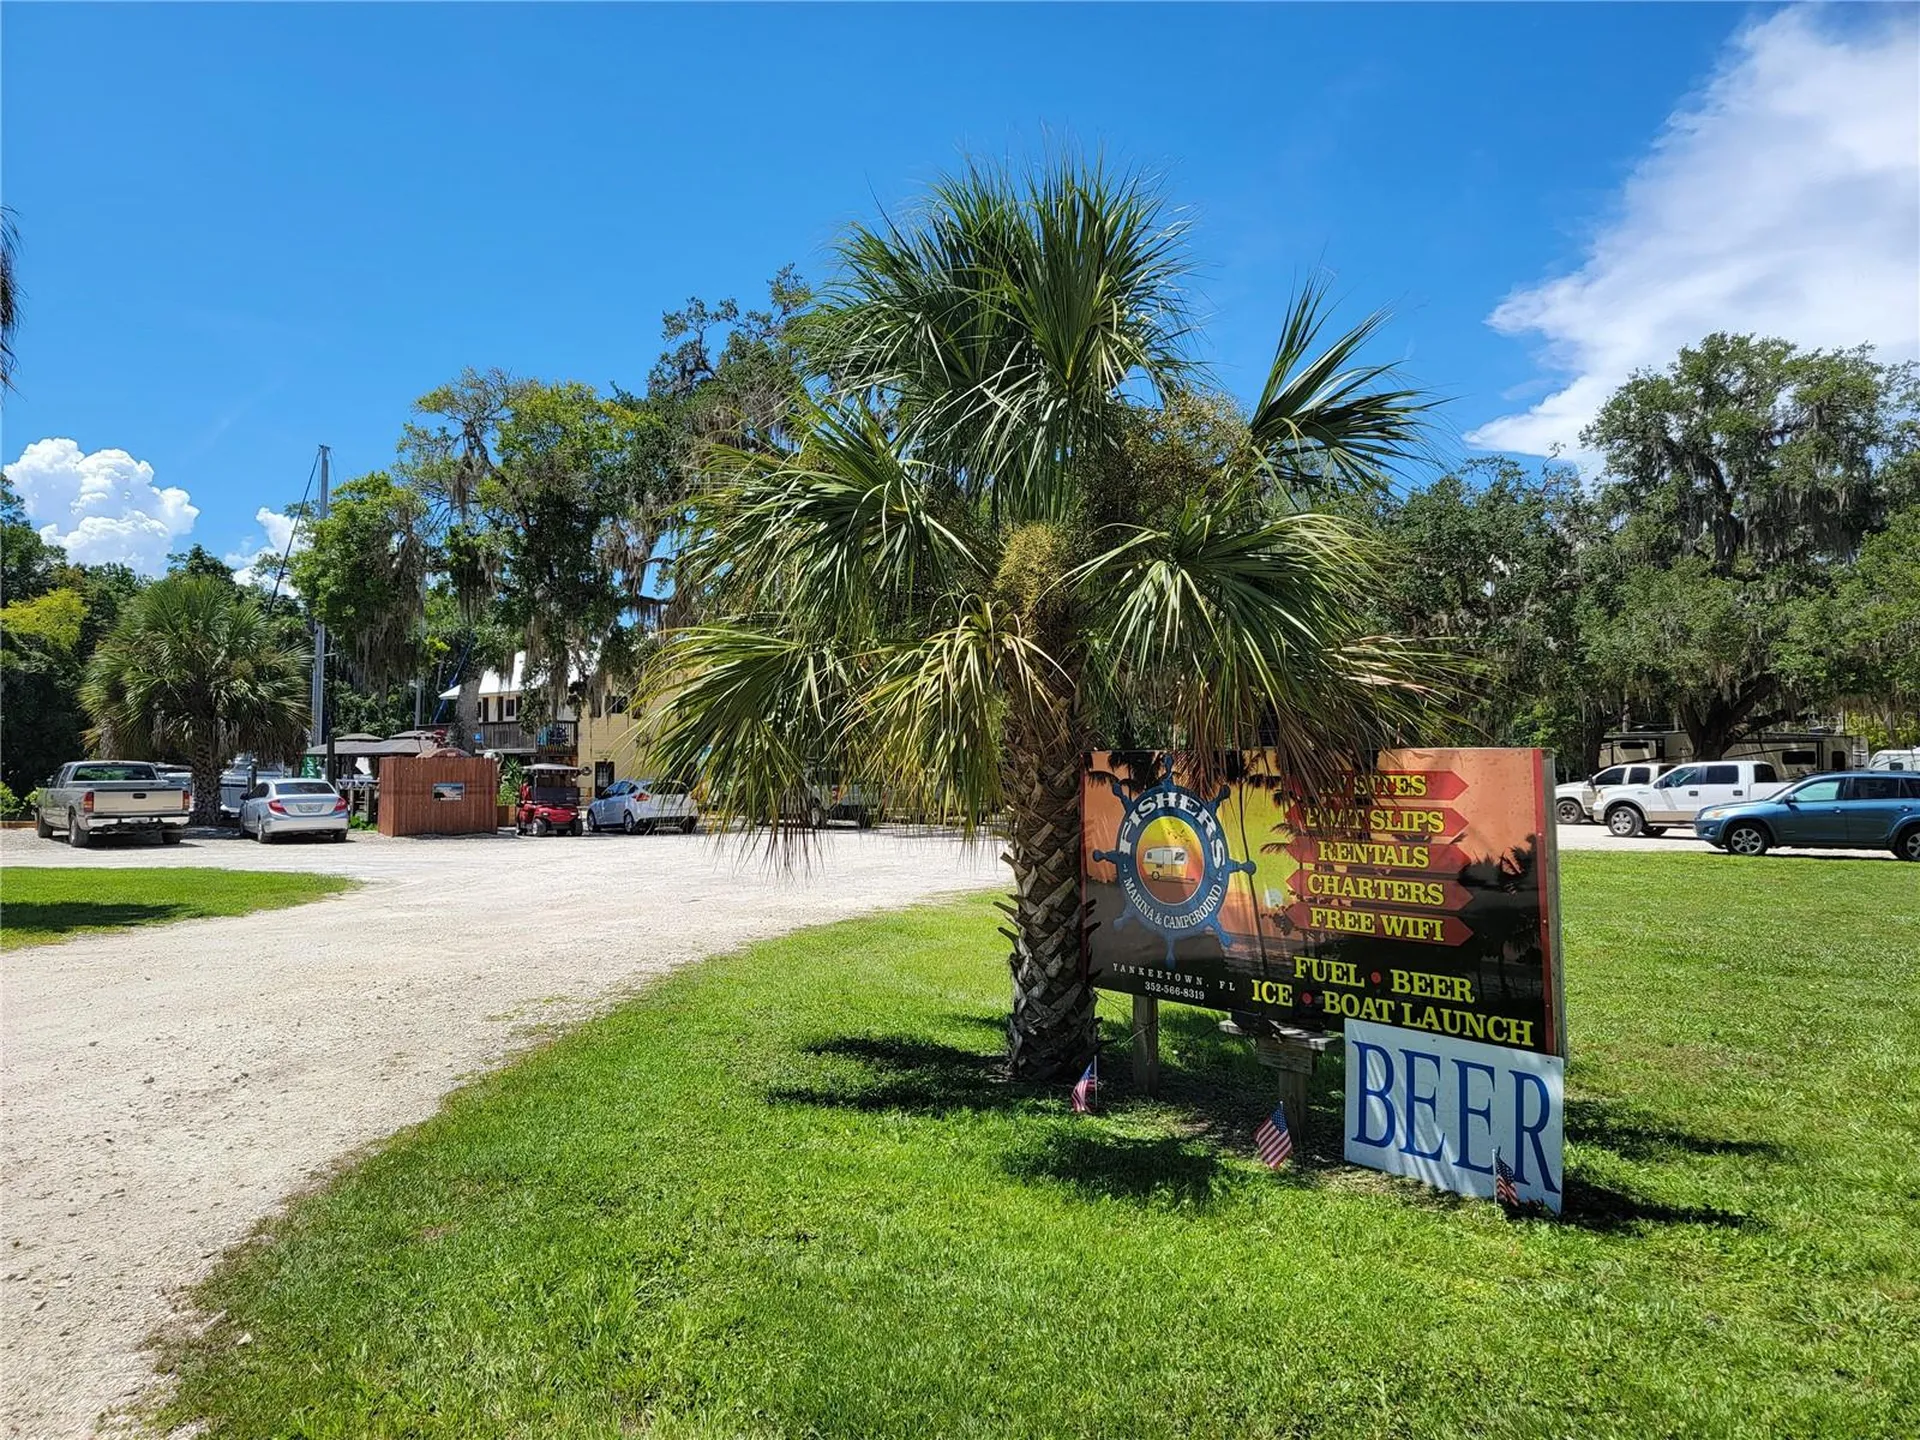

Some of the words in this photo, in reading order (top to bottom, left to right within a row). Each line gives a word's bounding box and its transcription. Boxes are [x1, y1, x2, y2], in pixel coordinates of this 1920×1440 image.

[1119, 792, 1225, 868] FISHERS
[1369, 810, 1445, 833] SLIPS
[1318, 841, 1429, 868] RENTALS
[1123, 876, 1155, 921] MARINA
[1154, 914, 1163, 925] &
[1163, 884, 1223, 930] CAMPGROUND
[1307, 874, 1444, 905] CHARTERS
[1310, 907, 1376, 933] FREE
[1380, 914, 1444, 941] WIFI
[1144, 981, 1205, 1000] 352-566-8319
[1219, 980, 1236, 991] FL
[1293, 956, 1365, 988] FUEL
[1390, 969, 1475, 1003] BEER
[1251, 979, 1293, 1007] ICE
[1322, 991, 1395, 1023] BOAT
[1401, 1003, 1534, 1046] LAUNCH
[1351, 1040, 1560, 1194] BEER
